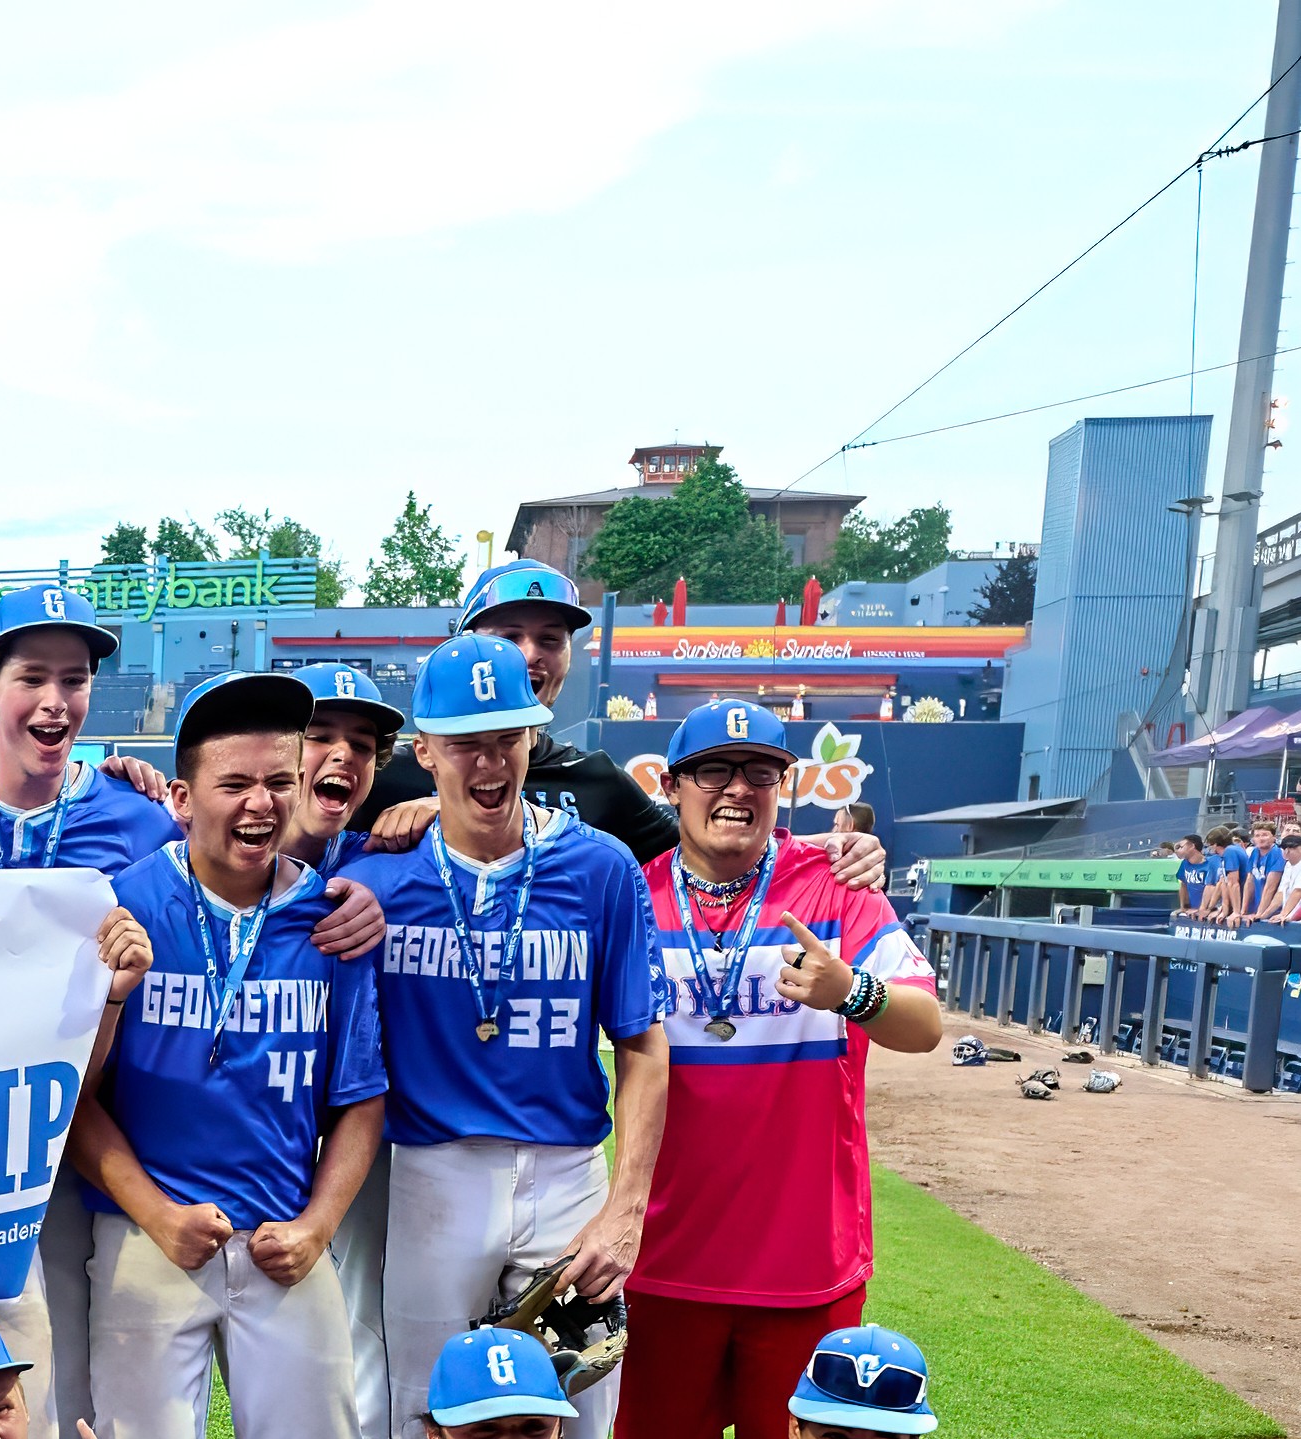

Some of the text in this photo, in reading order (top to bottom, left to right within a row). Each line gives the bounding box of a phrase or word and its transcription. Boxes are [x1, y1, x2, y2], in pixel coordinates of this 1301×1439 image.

[40, 589, 68, 621] G
[781, 638, 852, 660] Sundeck
[332, 670, 356, 700] G
[469, 659, 498, 702] G
[725, 706, 750, 740] G
[383, 923, 589, 982] GEOREOWN
[507, 998, 582, 1048] 33
[486, 1343, 517, 1386] G
